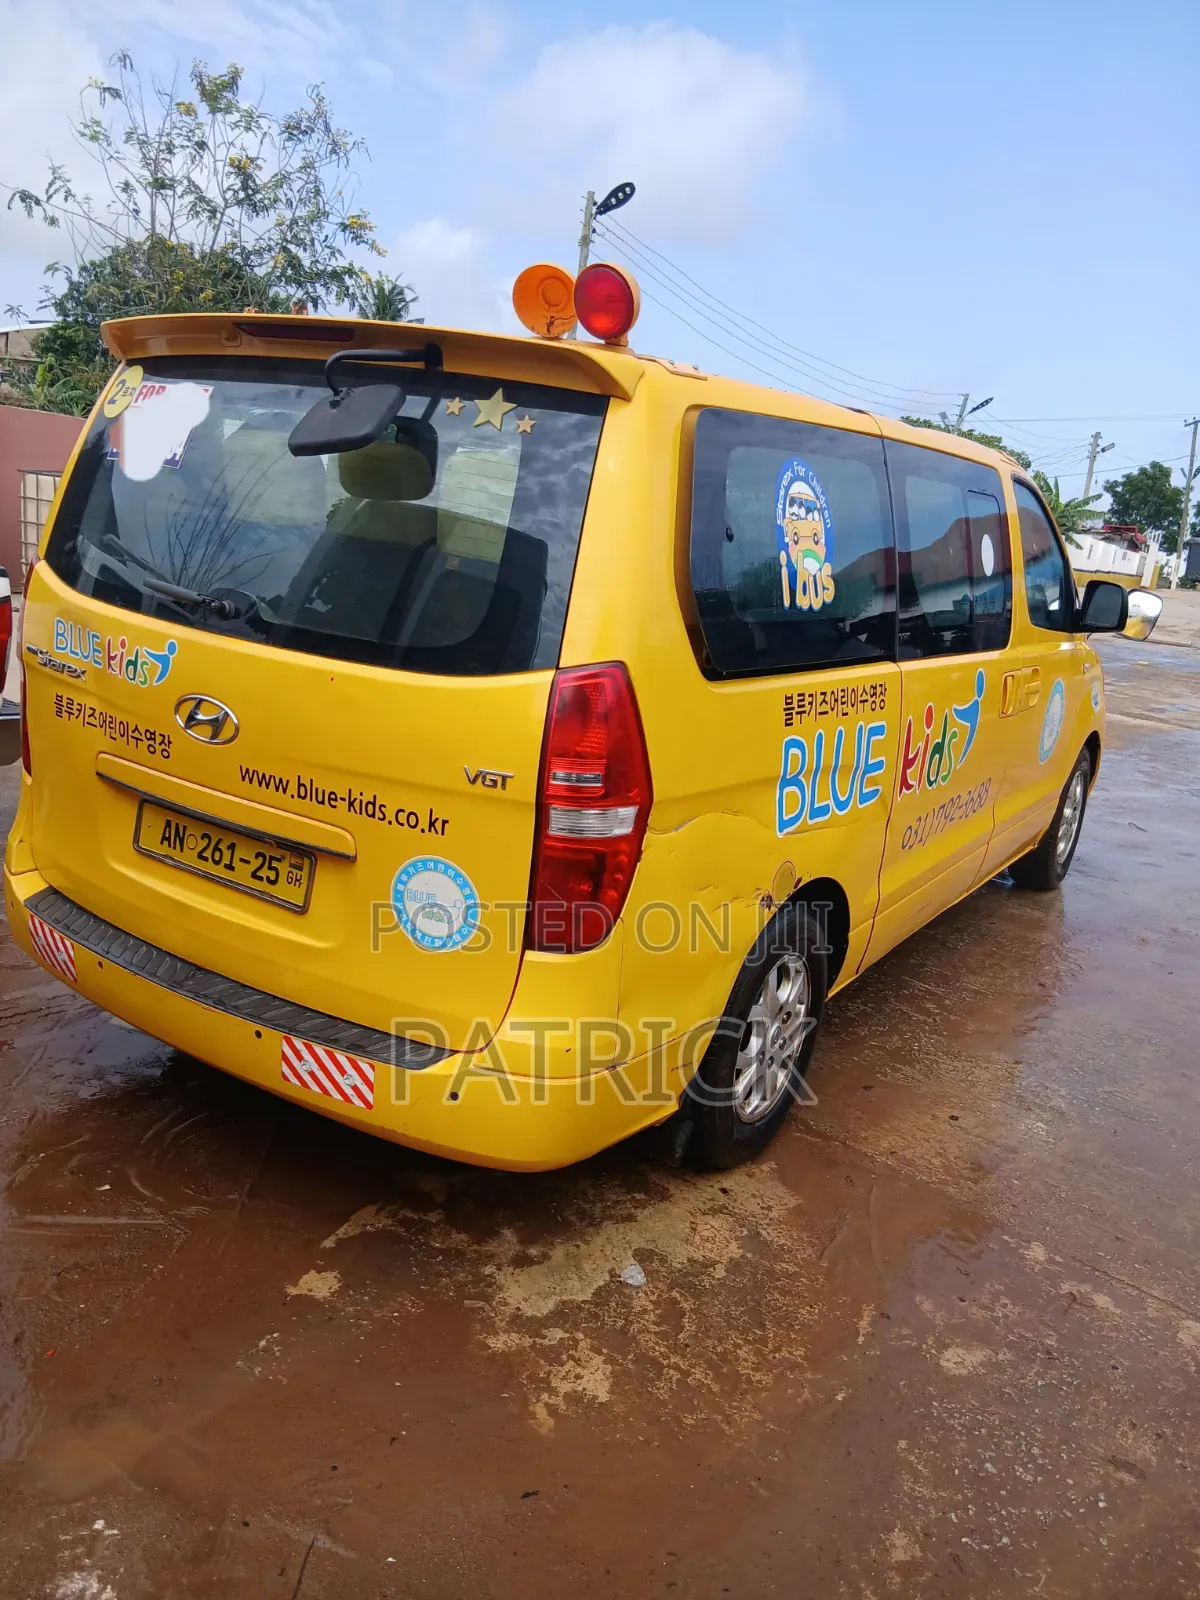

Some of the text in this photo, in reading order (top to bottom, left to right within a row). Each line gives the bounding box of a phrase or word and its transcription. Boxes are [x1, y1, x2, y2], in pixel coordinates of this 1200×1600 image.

[776, 461, 831, 528] Starex For Children
[795, 550, 835, 612] bus
[36, 648, 87, 682] Starex
[54, 617, 150, 688] BLUE kids
[54, 693, 172, 760] 블루키즈어린이수영장
[783, 681, 887, 728] 블루키즈어린이수영장
[239, 764, 450, 837] www.blue-kids.co.kr
[463, 765, 514, 791] VGT
[776, 721, 887, 838] BLUE
[898, 702, 959, 801] kids
[159, 818, 283, 886] AN 261-25
[286, 870, 304, 889] GH
[406, 889, 438, 906] BLUE
